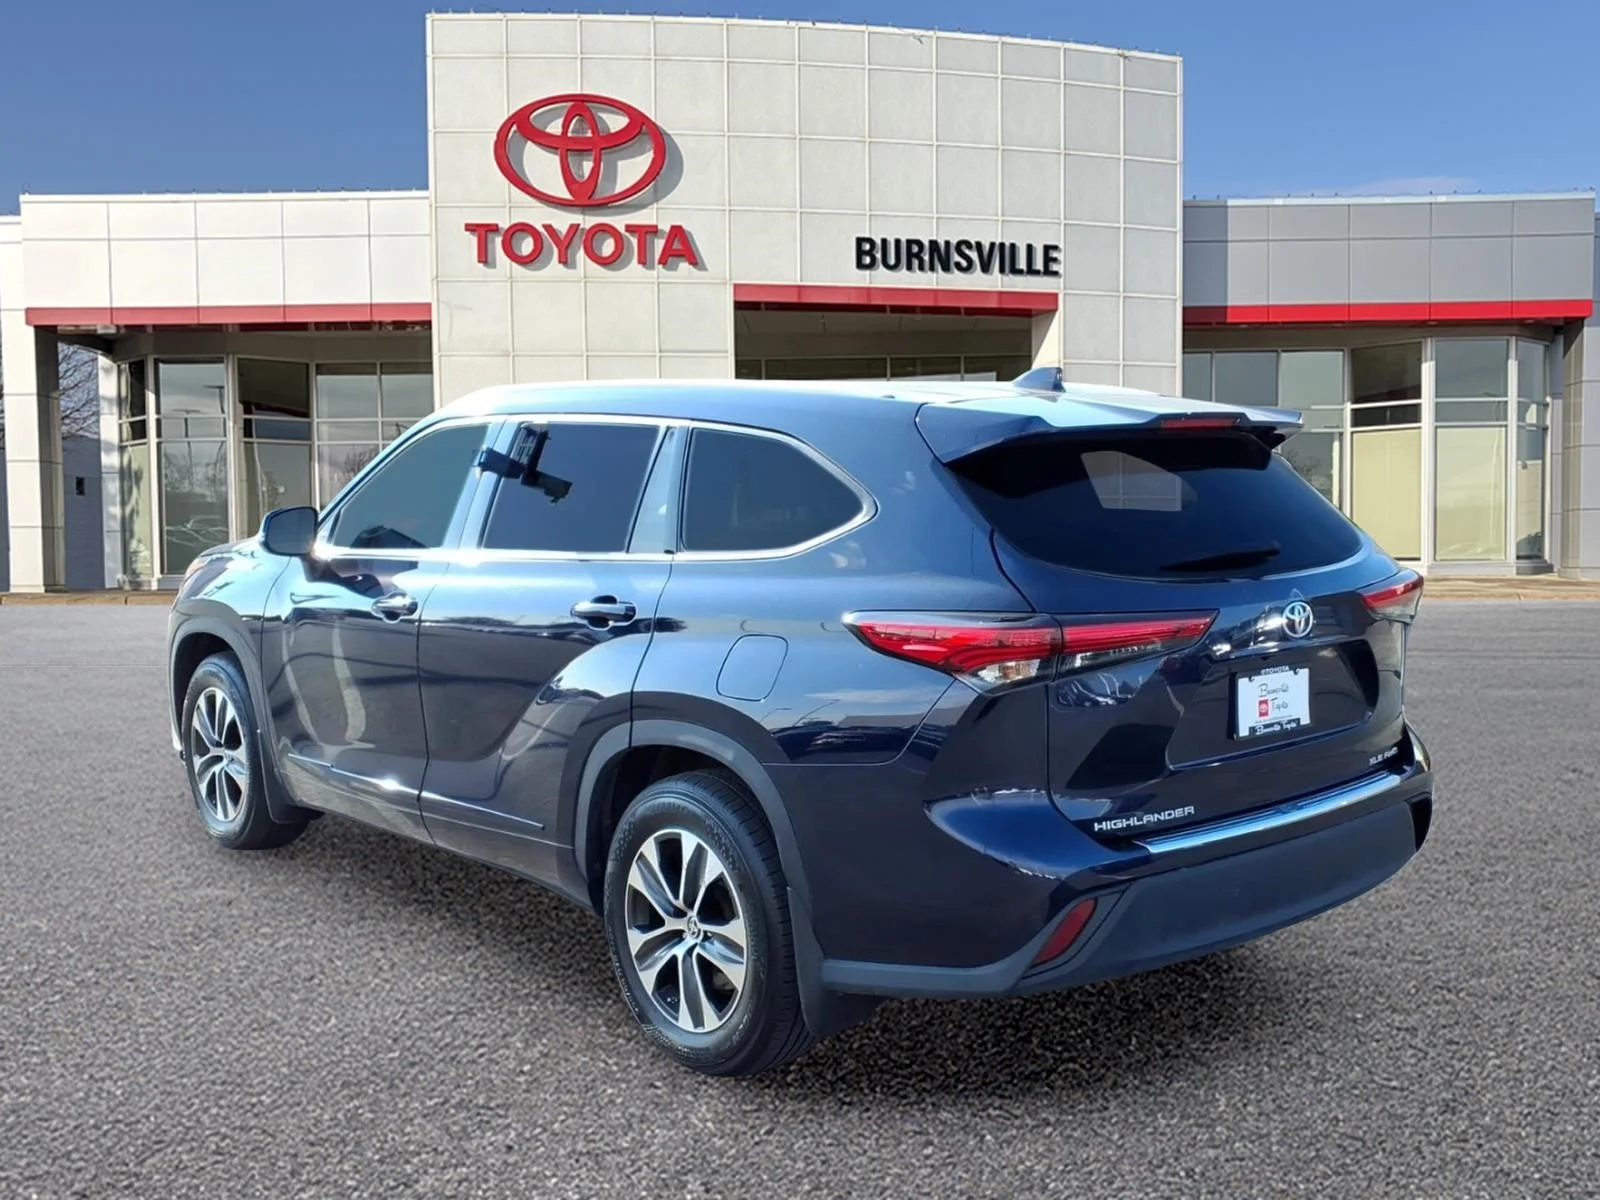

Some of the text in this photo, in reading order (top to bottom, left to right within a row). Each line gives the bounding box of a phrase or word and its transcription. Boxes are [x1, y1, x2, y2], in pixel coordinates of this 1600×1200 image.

[465, 223, 697, 266] TOYOTA
[855, 236, 1060, 275] BURNSVILLE
[1093, 805, 1195, 832] HIGHLANDER
